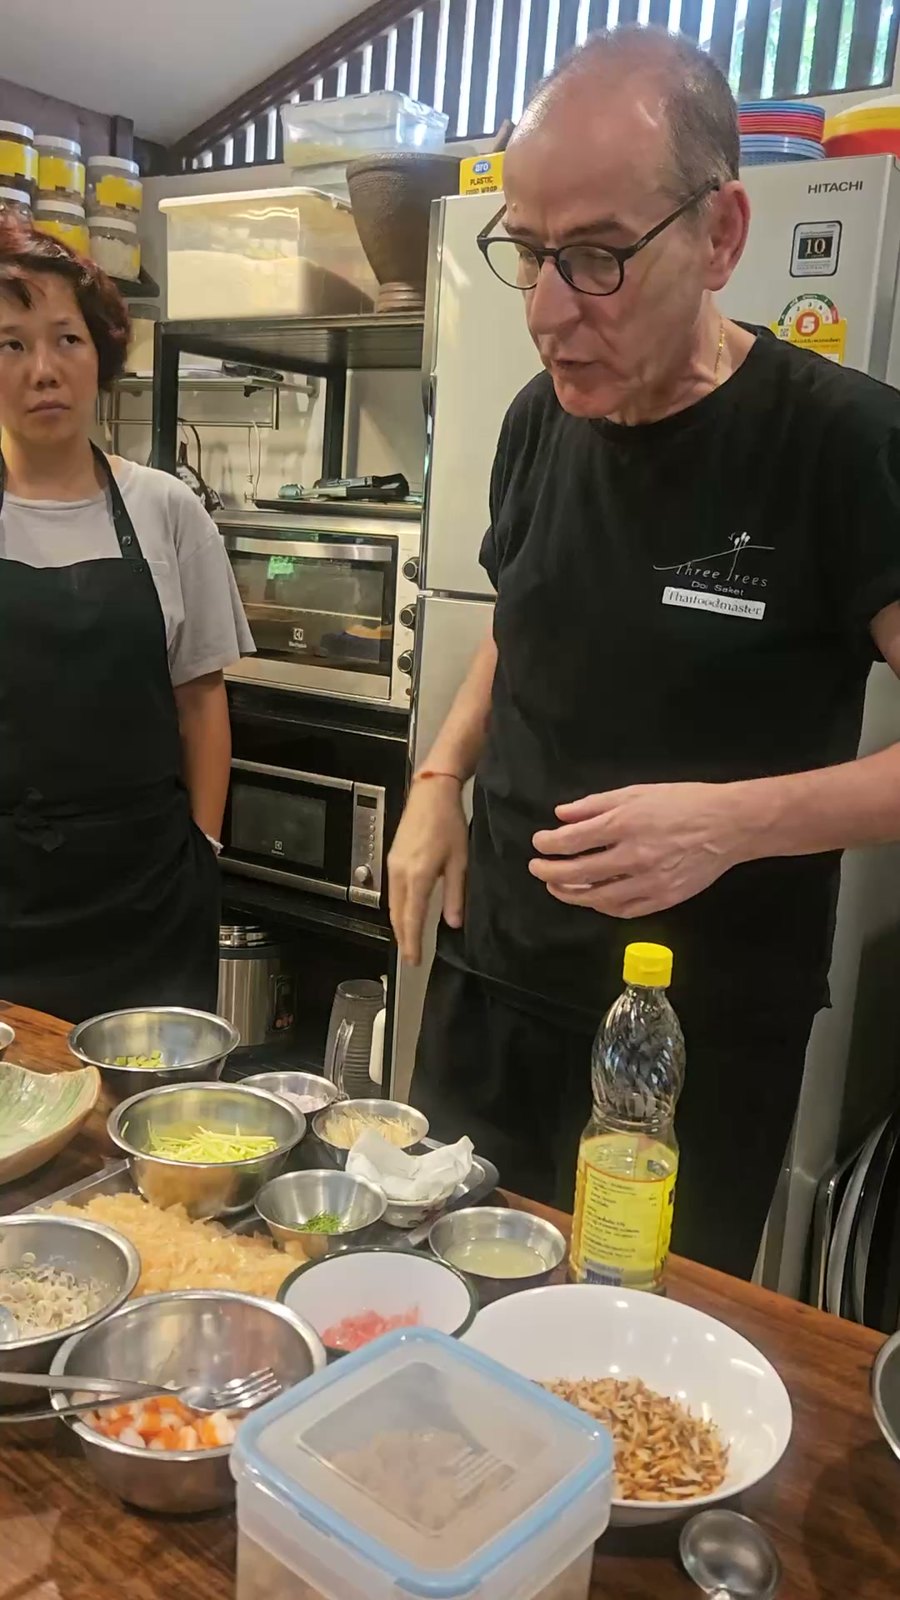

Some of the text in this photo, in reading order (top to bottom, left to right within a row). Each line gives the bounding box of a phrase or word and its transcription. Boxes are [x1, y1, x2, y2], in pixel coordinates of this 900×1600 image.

[470, 176, 494, 186] PLASTIC
[808, 180, 864, 194] HITACHI
[805, 238, 826, 255] 10
[800, 316, 816, 334] 5
[676, 562, 720, 579] Three
